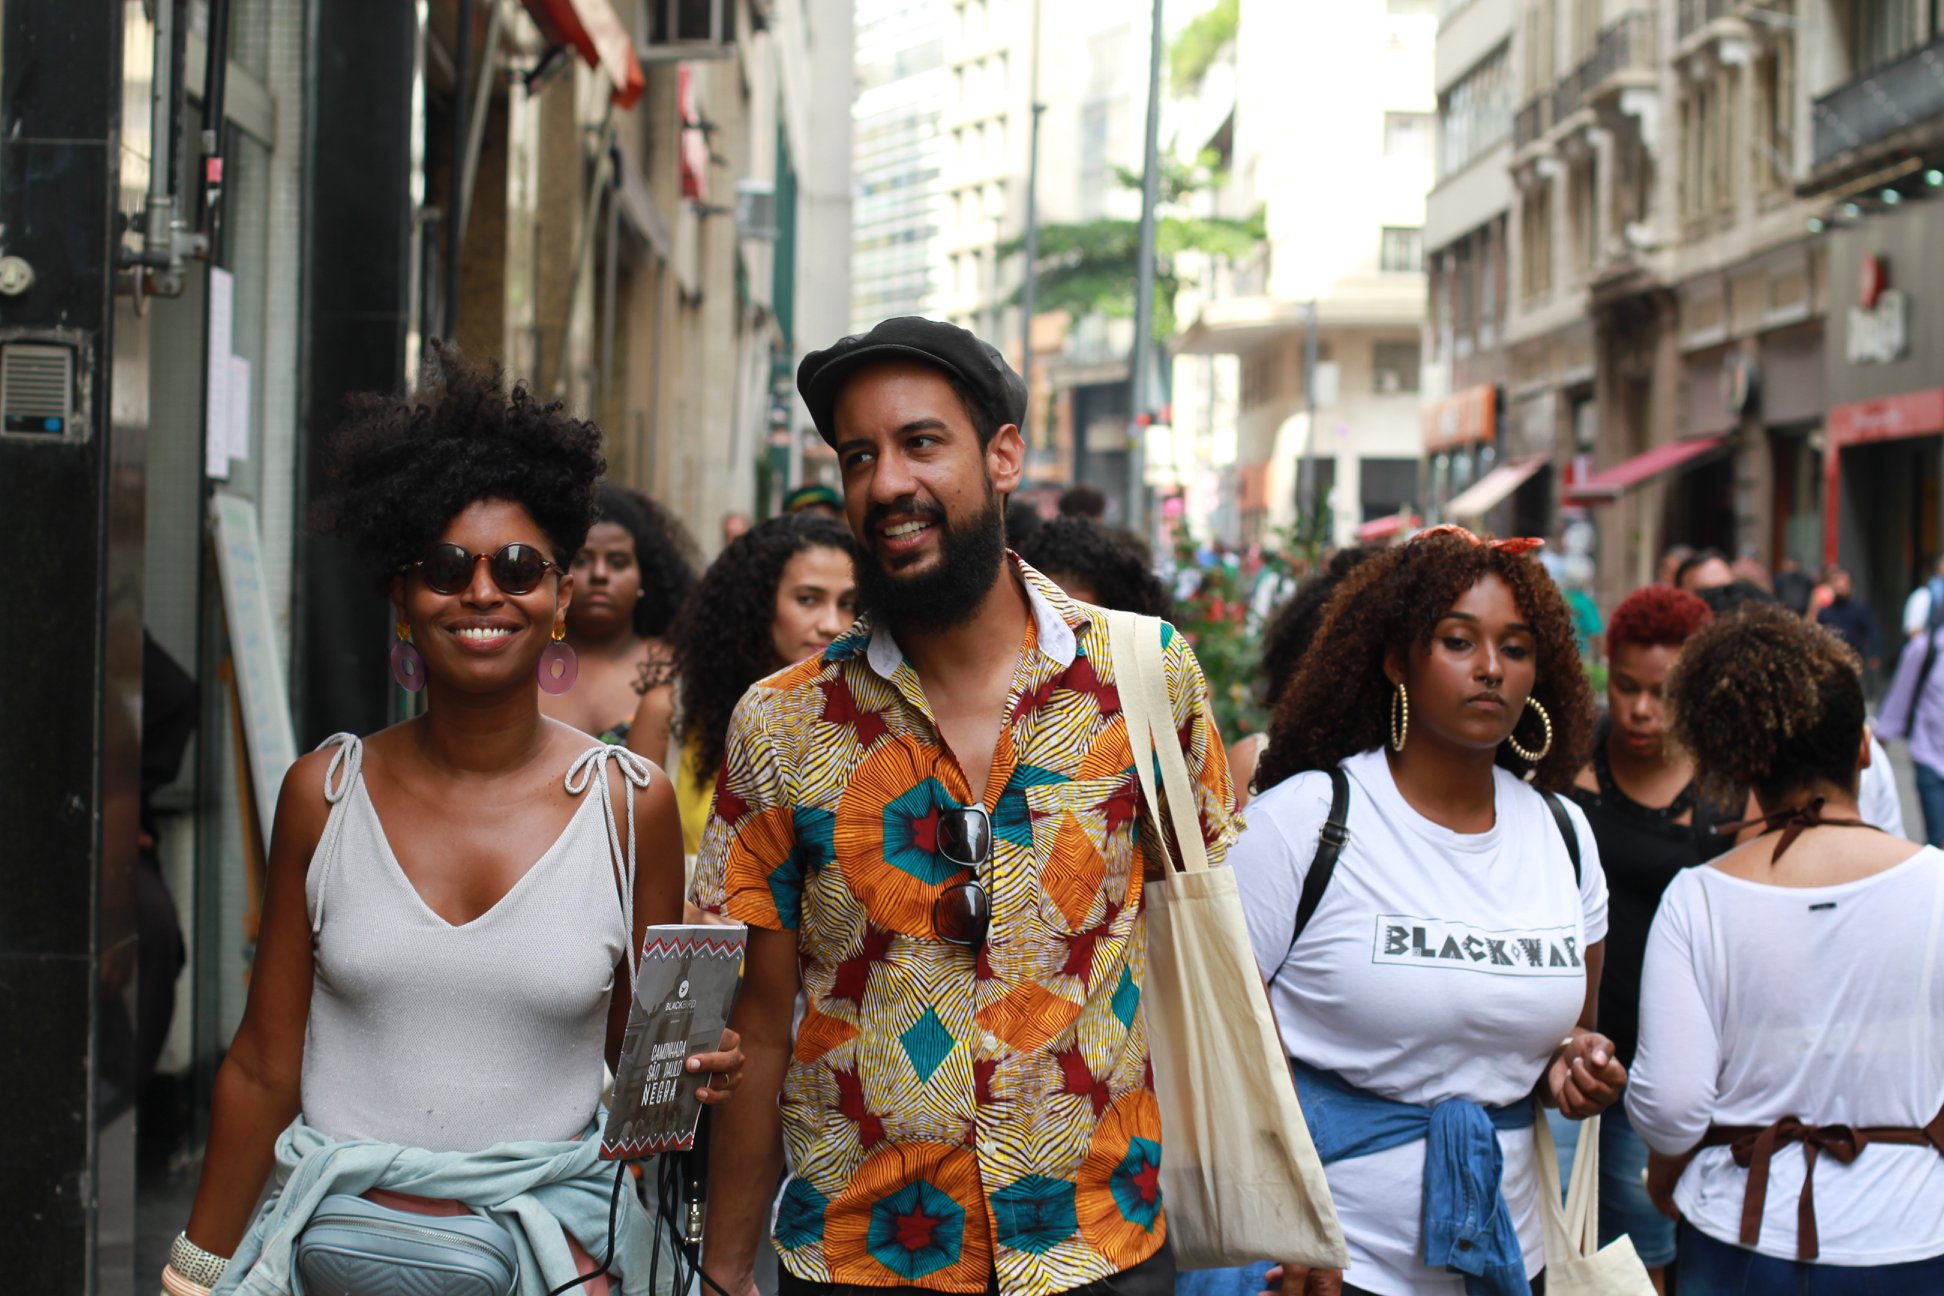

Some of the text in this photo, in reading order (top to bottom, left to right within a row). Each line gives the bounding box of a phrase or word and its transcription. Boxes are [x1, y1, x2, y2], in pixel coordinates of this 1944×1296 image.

[651, 1040, 687, 1061] CAMINHADA
[647, 1059, 683, 1082] SÃO PAULO
[641, 1078, 677, 1107] NEGRA
